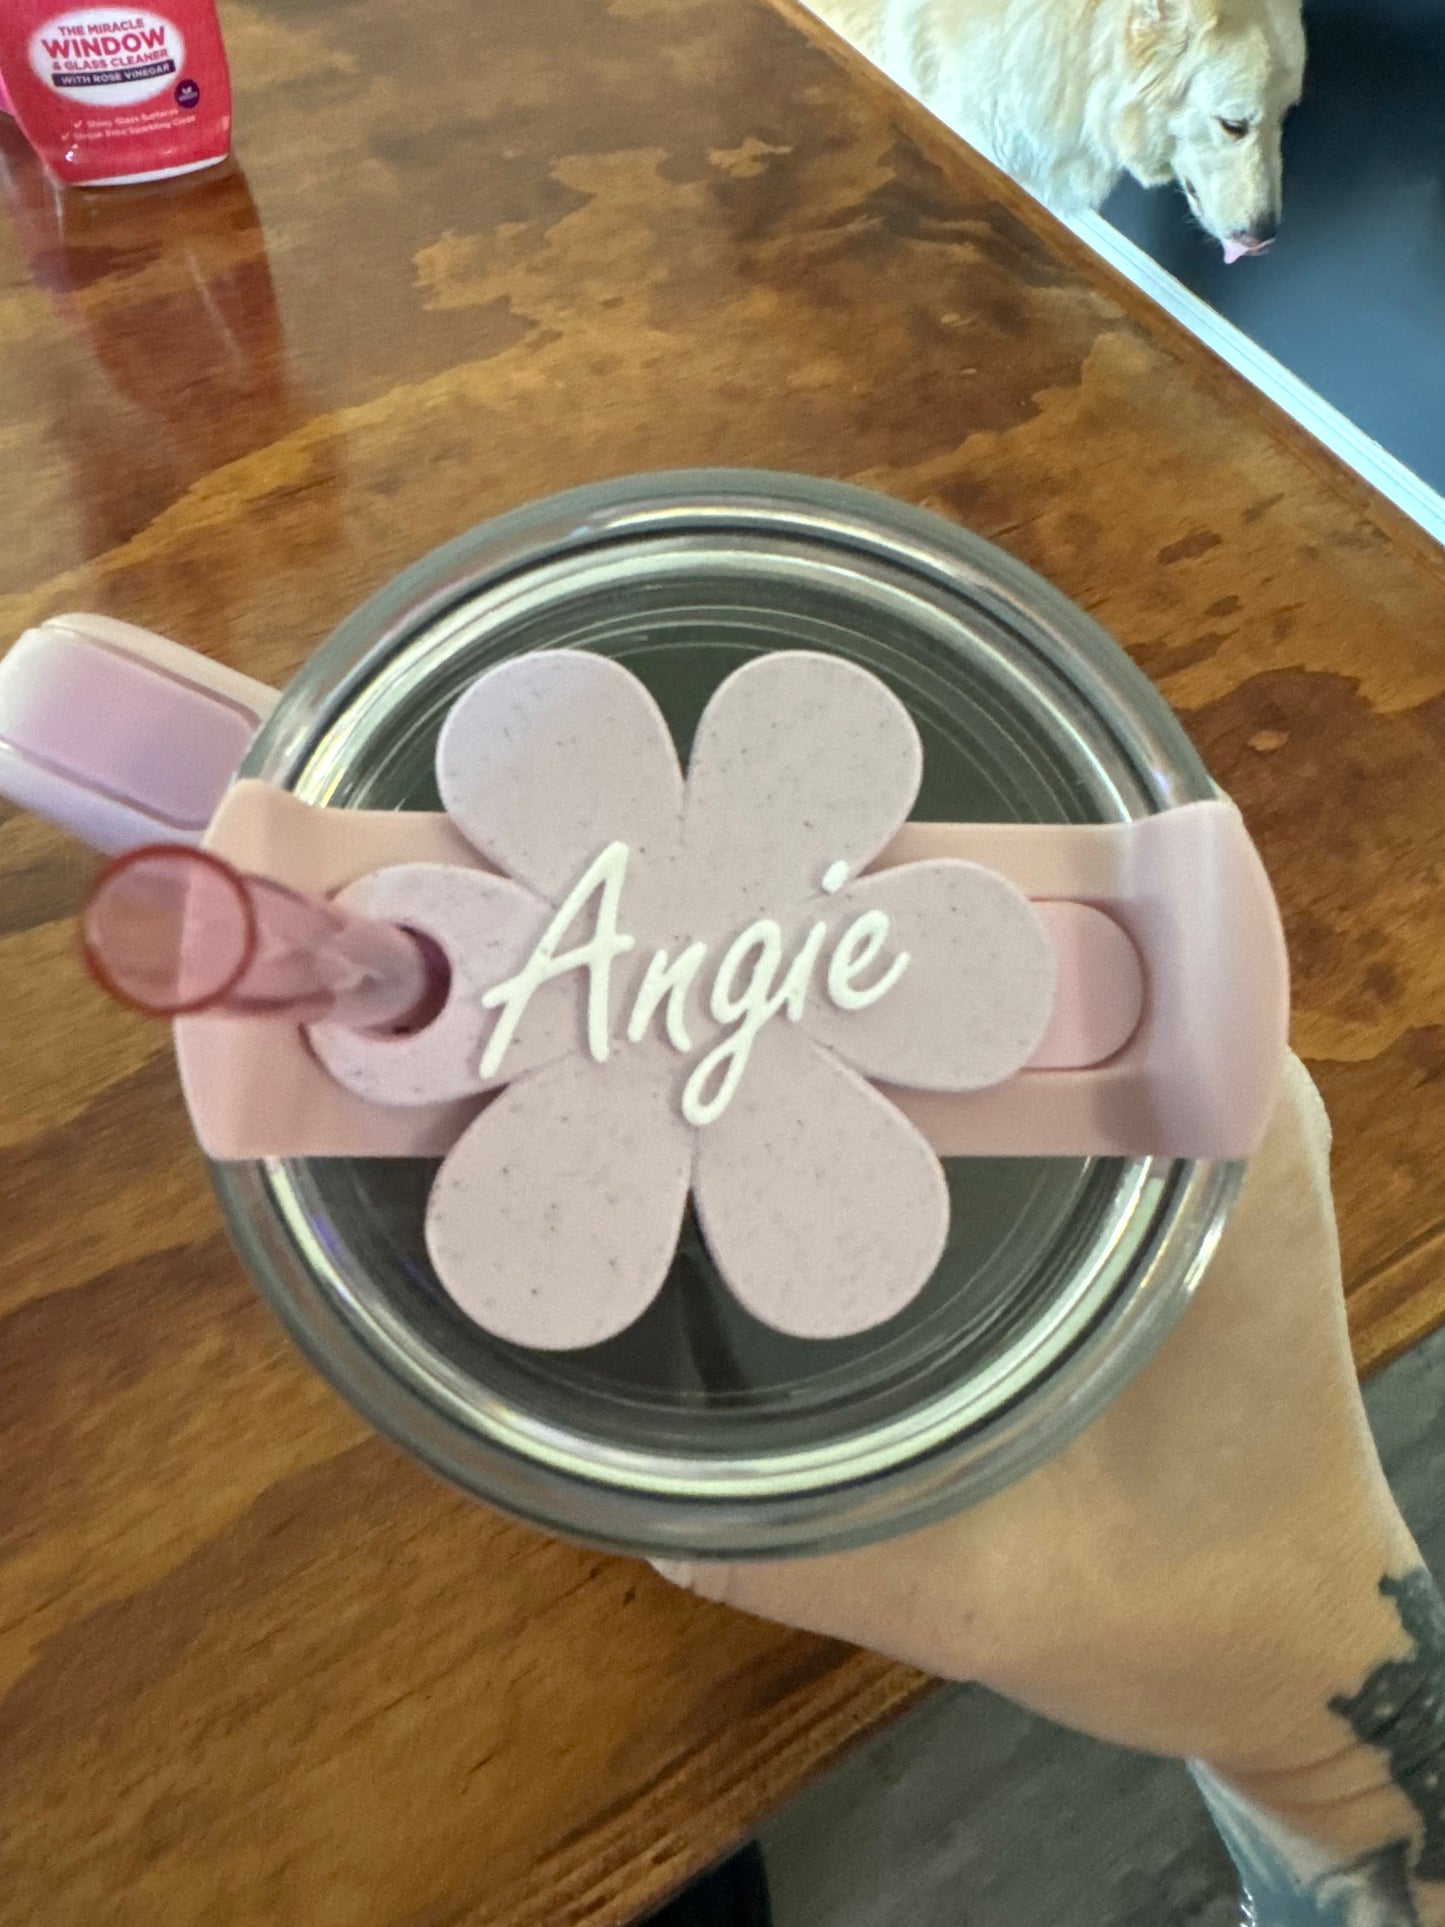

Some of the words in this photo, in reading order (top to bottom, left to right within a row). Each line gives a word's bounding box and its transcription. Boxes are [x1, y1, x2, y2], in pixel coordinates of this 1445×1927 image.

[58, 26, 85, 36] THE
[88, 18, 145, 34] MIRACLE
[41, 26, 165, 59] WINDOW
[53, 61, 62, 70] &
[64, 59, 108, 70] GLASS
[110, 49, 169, 67] CLEANER
[93, 71, 122, 82] ROSE
[479, 840, 911, 1126] Angie
